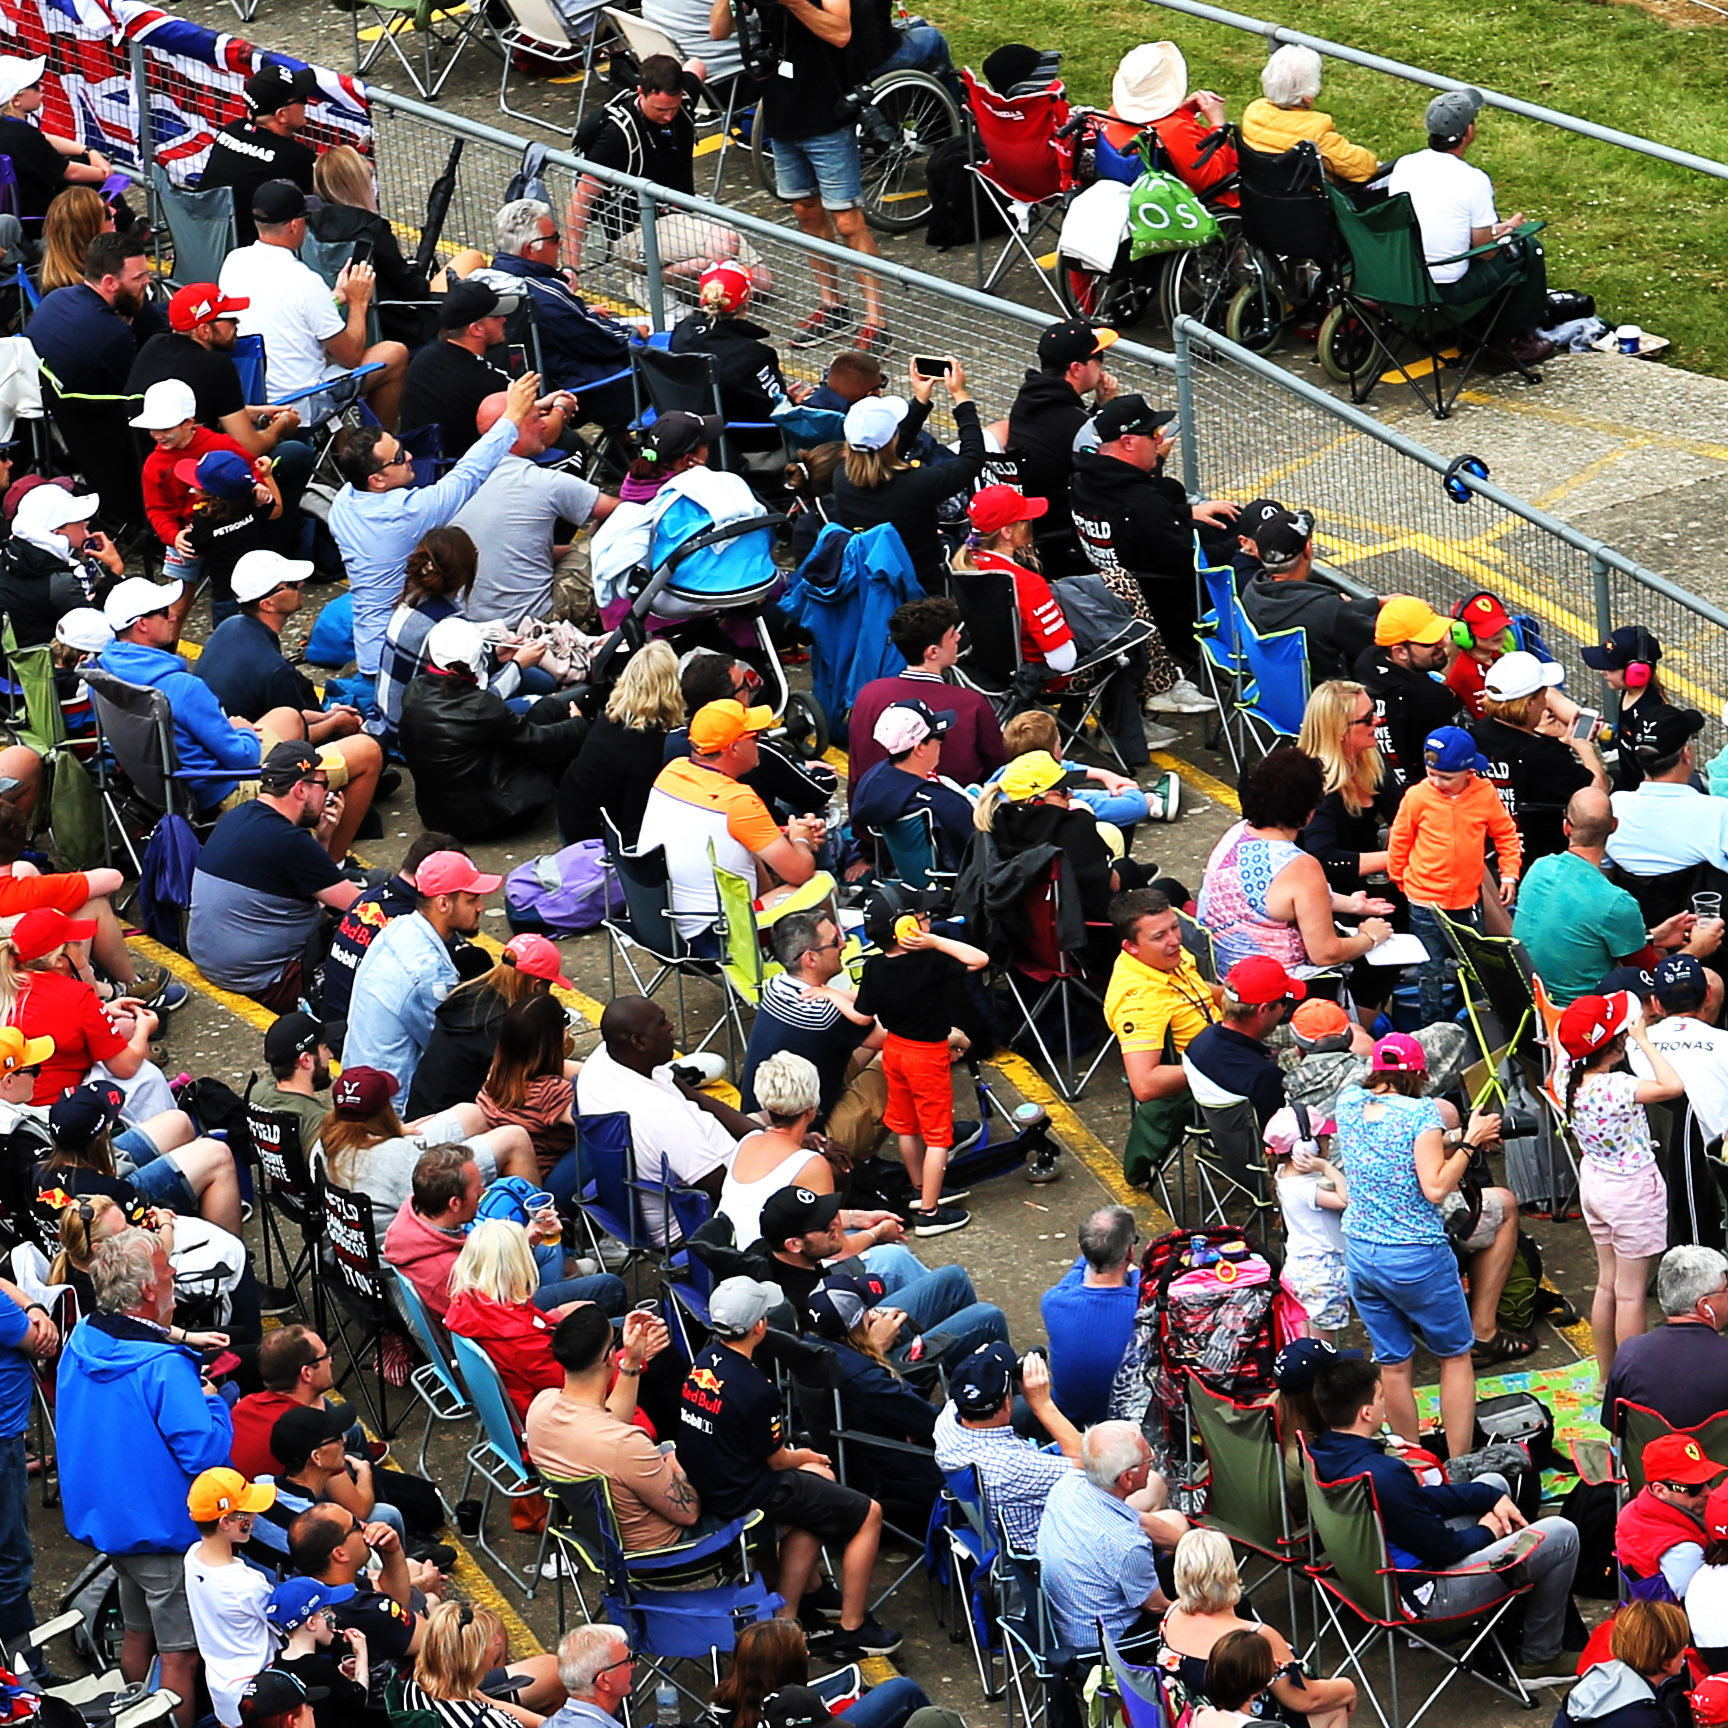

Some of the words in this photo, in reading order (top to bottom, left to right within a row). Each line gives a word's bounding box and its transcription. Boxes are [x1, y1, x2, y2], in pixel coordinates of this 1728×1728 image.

[213, 515, 254, 538] PETRONAS
[682, 1382, 700, 1404] Red
[697, 1391, 723, 1415] Bull
